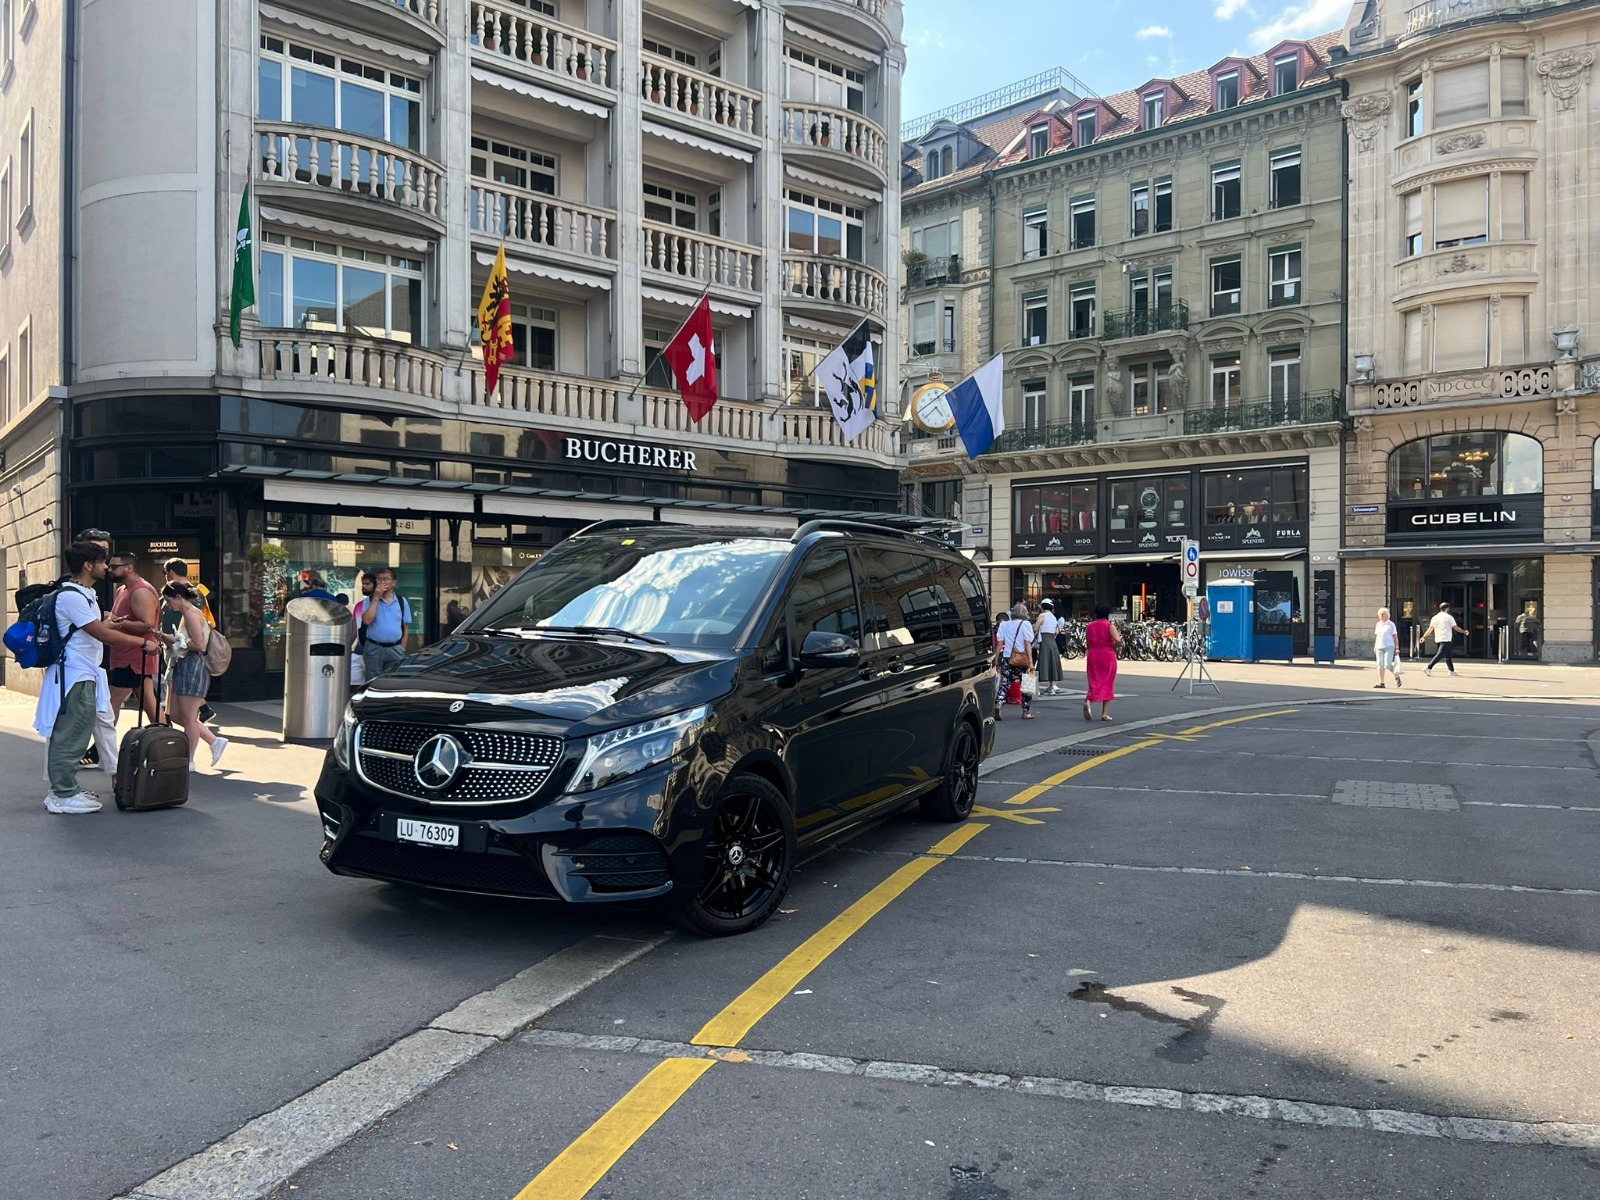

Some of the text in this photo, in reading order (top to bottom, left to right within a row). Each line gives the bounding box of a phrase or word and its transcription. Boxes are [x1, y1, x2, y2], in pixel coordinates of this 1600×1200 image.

[565, 437, 697, 470] BUCHERER
[1411, 510, 1516, 525] GÜBELIN
[327, 543, 366, 551] BUCHERER
